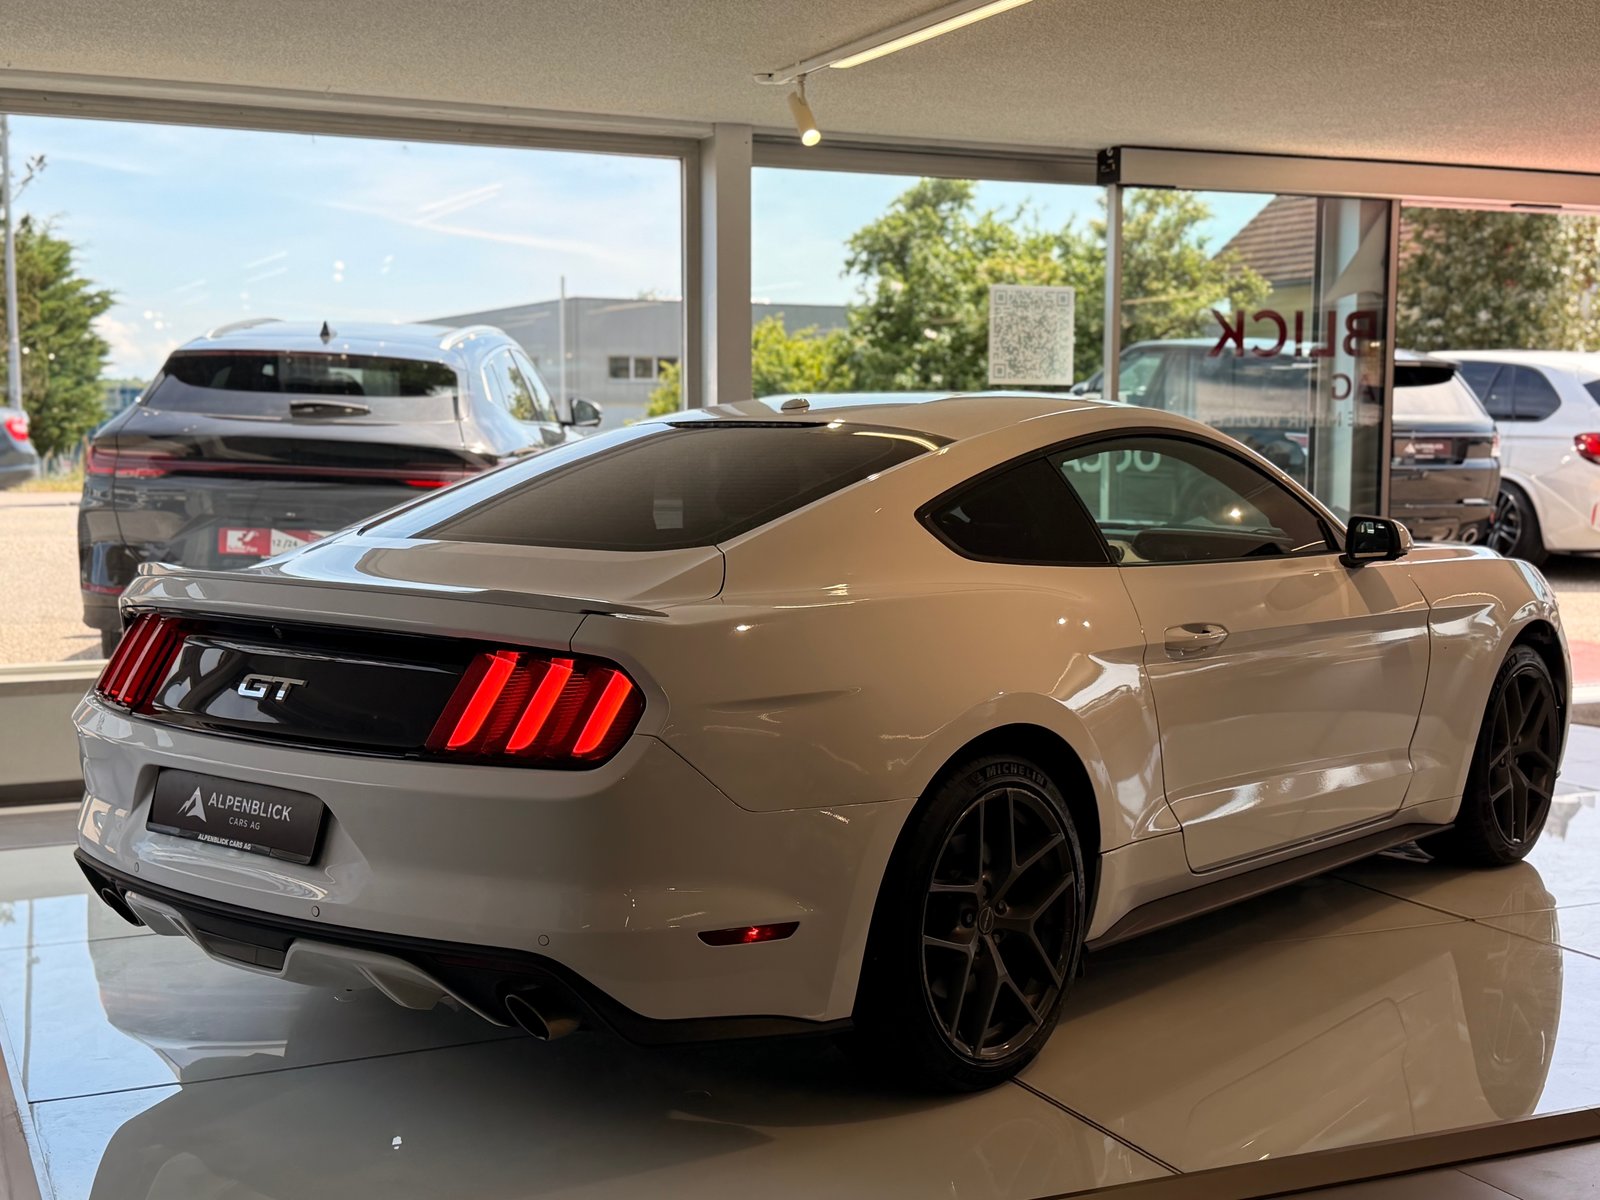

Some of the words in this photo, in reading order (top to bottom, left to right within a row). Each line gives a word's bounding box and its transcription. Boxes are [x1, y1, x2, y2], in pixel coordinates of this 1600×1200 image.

[238, 673, 306, 701] GT
[985, 763, 1046, 786] MICHELIN
[208, 792, 292, 821] ALPENBLICK
[229, 816, 248, 828] CARS
[250, 822, 260, 830] AG
[198, 833, 229, 845] ALPENBLICK
[229, 839, 243, 848] CARS
